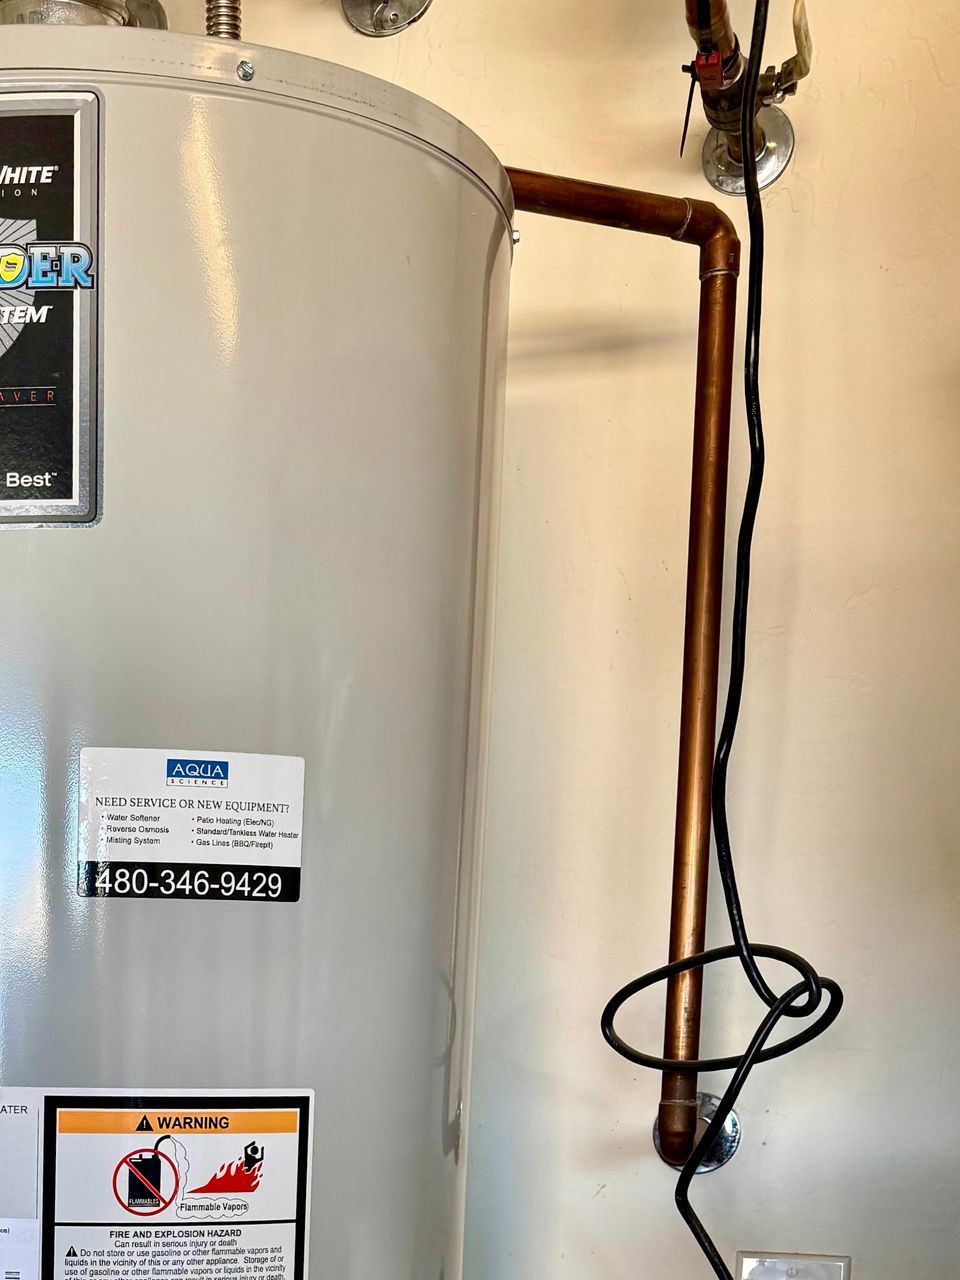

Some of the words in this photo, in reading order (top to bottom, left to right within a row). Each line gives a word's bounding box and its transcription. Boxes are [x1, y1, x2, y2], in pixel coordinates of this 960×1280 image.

[6, 472, 52, 487] Best
[173, 763, 224, 778] AQUA
[96, 796, 129, 809] NEED
[128, 797, 177, 810] SERVICE
[179, 799, 195, 809] OR
[197, 800, 223, 810] NEW
[224, 801, 290, 814] EQUIPMENT?
[107, 813, 128, 822] Water
[130, 814, 161, 822] Softener
[197, 816, 215, 824] Patio
[216, 817, 242, 826] Heating
[107, 825, 137, 833] Reverse
[138, 826, 170, 834] Osmosis
[258, 830, 277, 838] Water
[278, 831, 299, 839] Heater
[106, 836, 132, 845] Misting
[134, 837, 161, 846] System
[196, 838, 211, 848] Gas
[212, 839, 230, 847] Lines
[95, 868, 282, 898] 480-346-9429
[158, 1117, 230, 1130] WARNING
[180, 1203, 221, 1212] Flammable
[222, 1203, 248, 1212] Vapors
[110, 1230, 131, 1239] FIRE
[132, 1230, 153, 1239] AND
[154, 1230, 205, 1239] EXPLOSION
[207, 1229, 242, 1238] HAZARD
[115, 1240, 130, 1248] Can
[132, 1240, 152, 1248] result
[154, 1240, 160, 1248] in
[190, 1240, 208, 1249] injury
[219, 1239, 237, 1247] death
[80, 1249, 91, 1257] Do
[152, 1250, 181, 1258] gasoline
[212, 1248, 246, 1256] flammable
[65, 1259, 89, 1267] liquids
[113, 1259, 138, 1267] vicinity
[172, 1259, 185, 1267] any
[206, 1258, 240, 1266] appliance.
[244, 1256, 269, 1264] Storage
